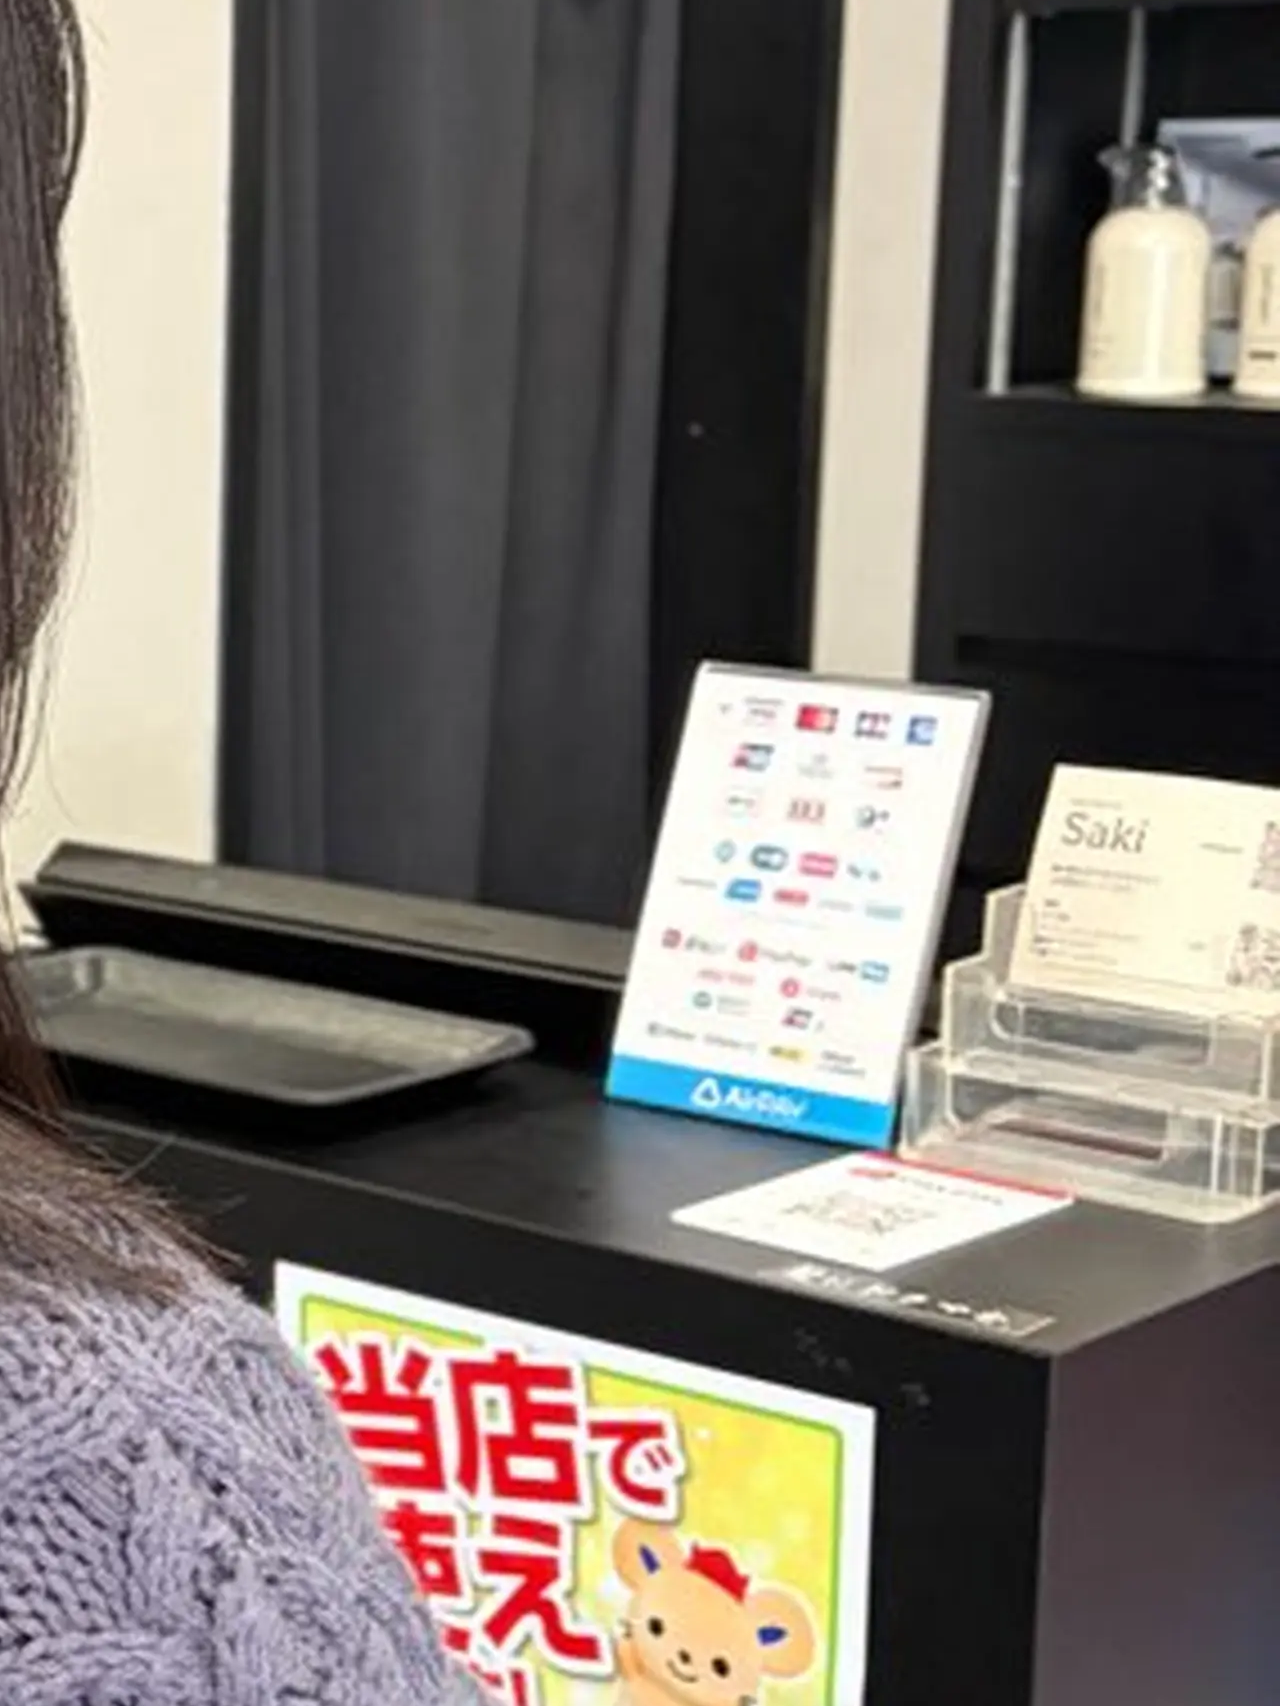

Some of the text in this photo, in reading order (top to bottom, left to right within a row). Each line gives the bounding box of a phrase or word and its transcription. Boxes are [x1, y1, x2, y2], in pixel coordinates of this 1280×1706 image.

[1060, 810, 1151, 854] Saki
[314, 1339, 674, 1508] 当店で
